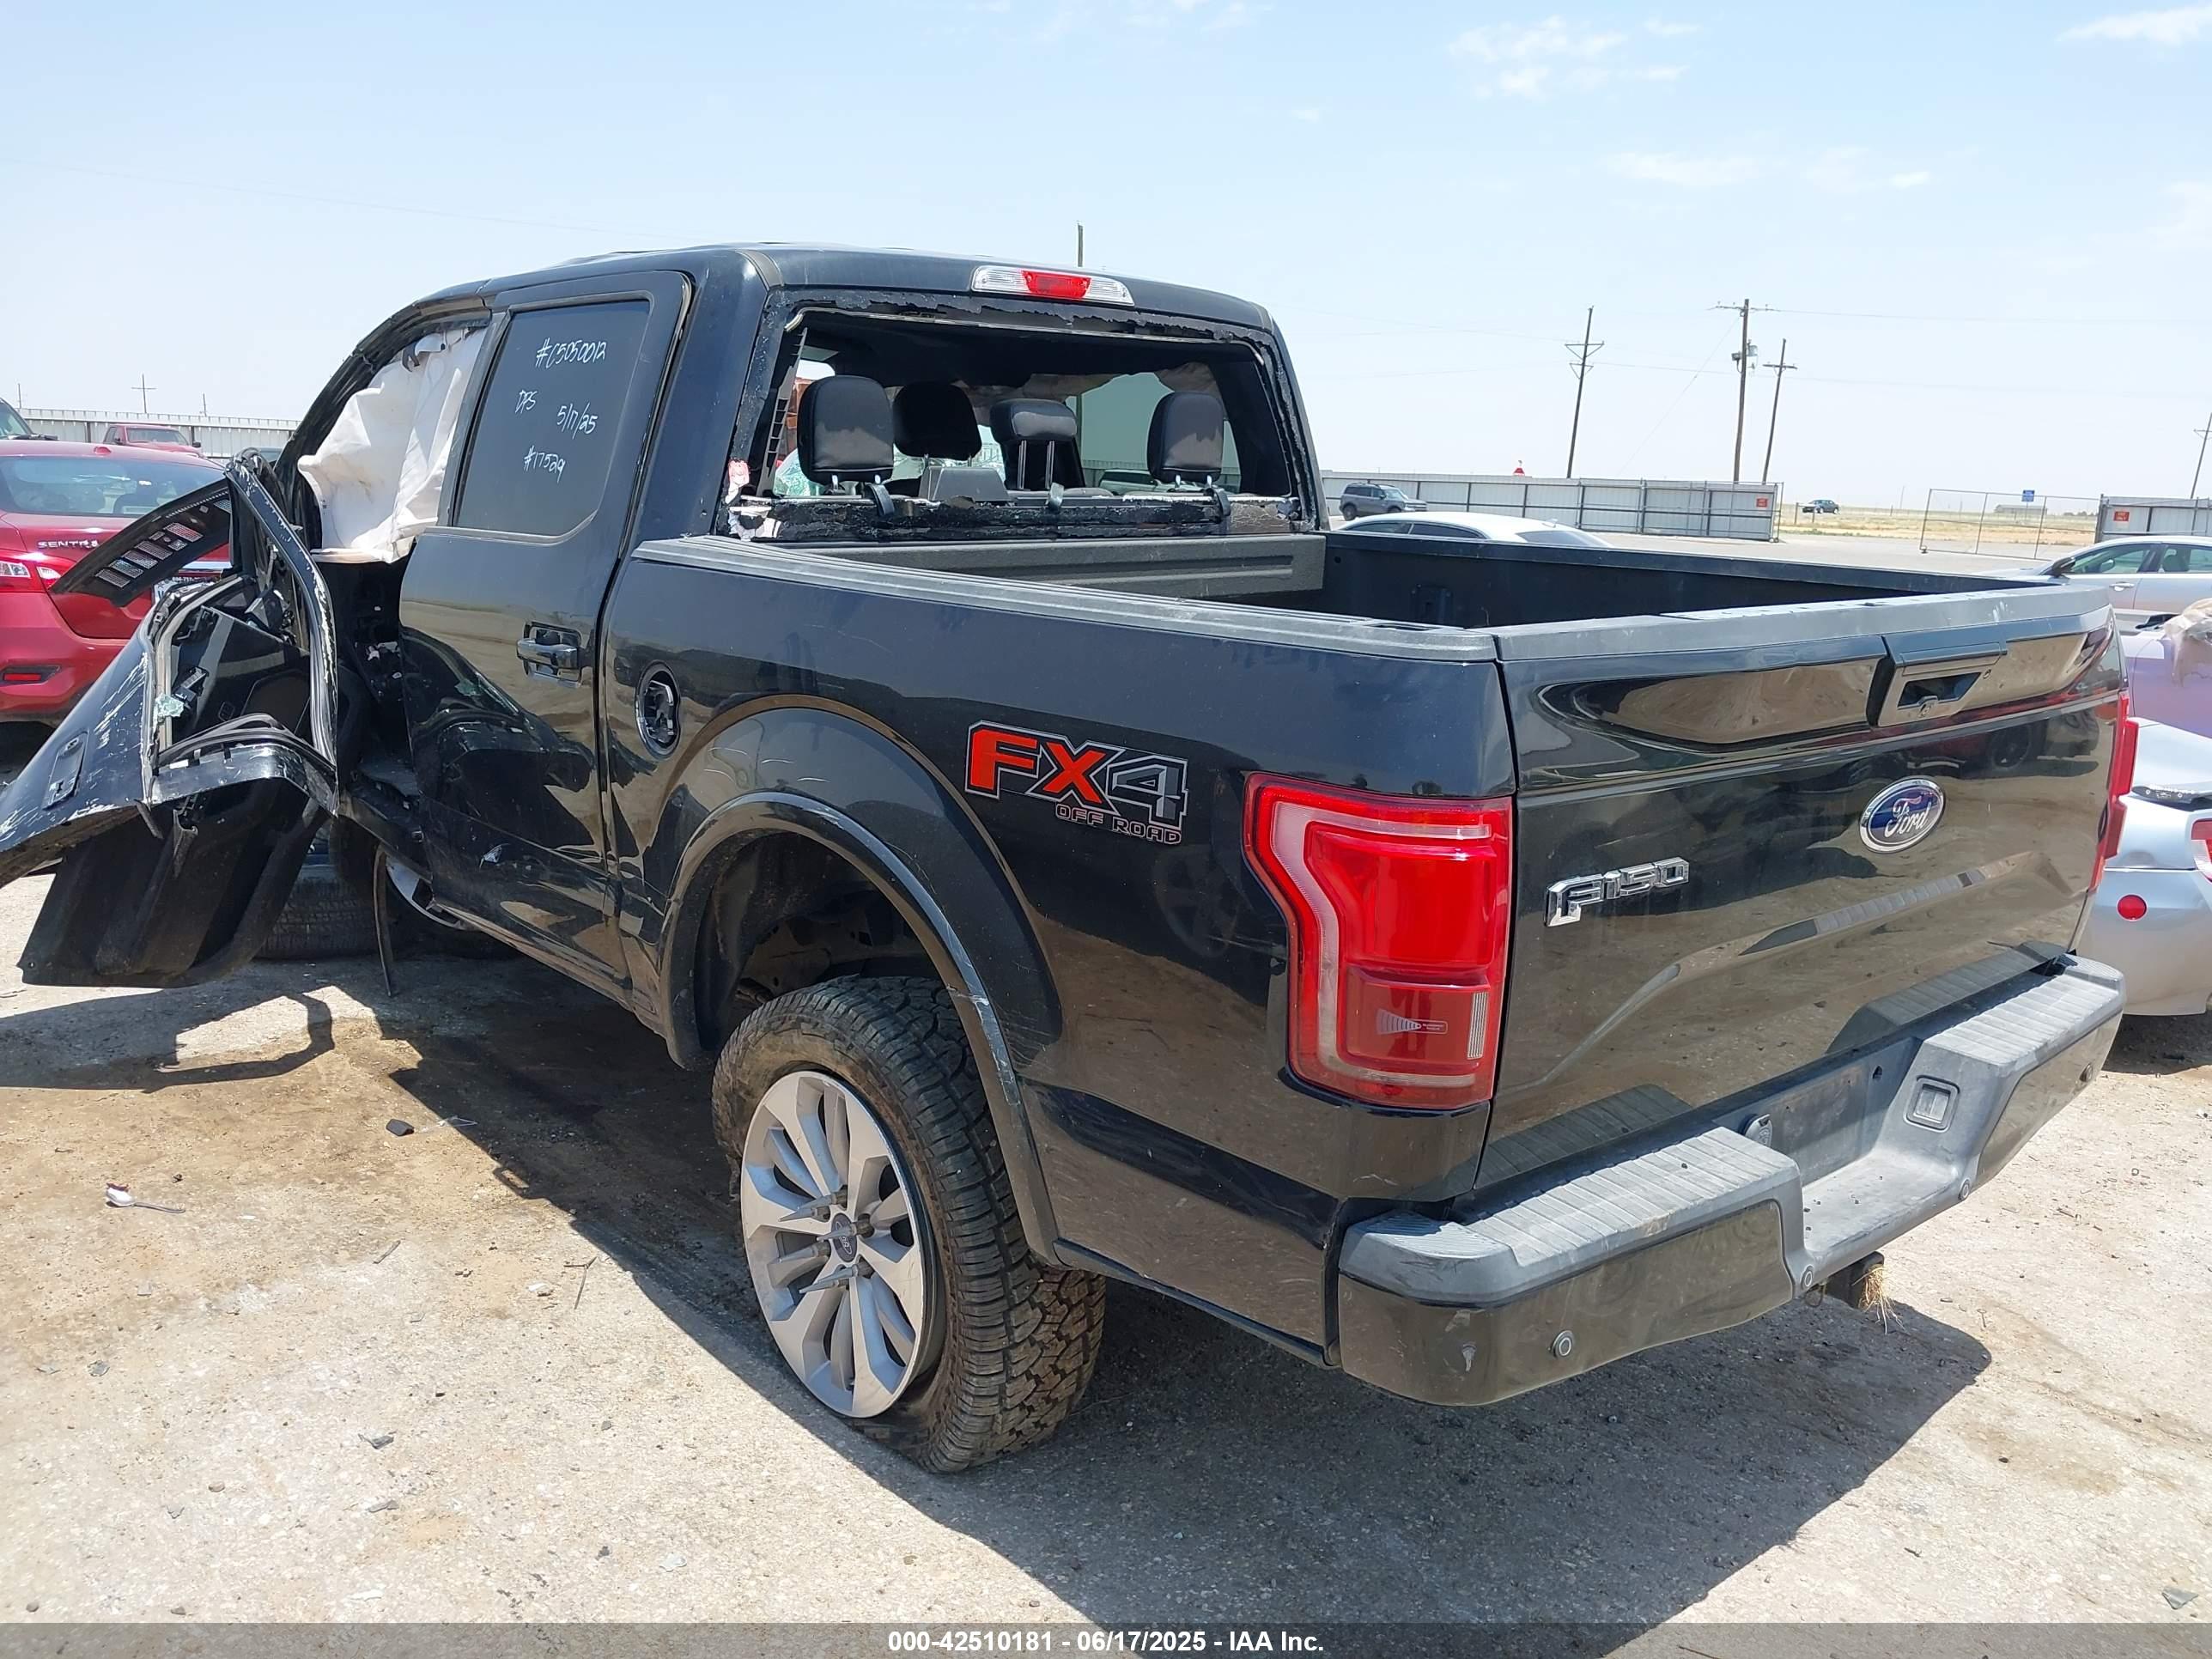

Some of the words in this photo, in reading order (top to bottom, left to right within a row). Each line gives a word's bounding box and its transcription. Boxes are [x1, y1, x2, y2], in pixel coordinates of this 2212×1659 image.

[514, 389, 538, 414] DPS
[556, 402, 599, 440] 5/17/25
[523, 445, 566, 483] #17529
[964, 720, 1189, 830] FX4
[1055, 804, 1105, 825] OFF
[1113, 816, 1182, 845] ROAD
[1883, 797, 1936, 838] Ford
